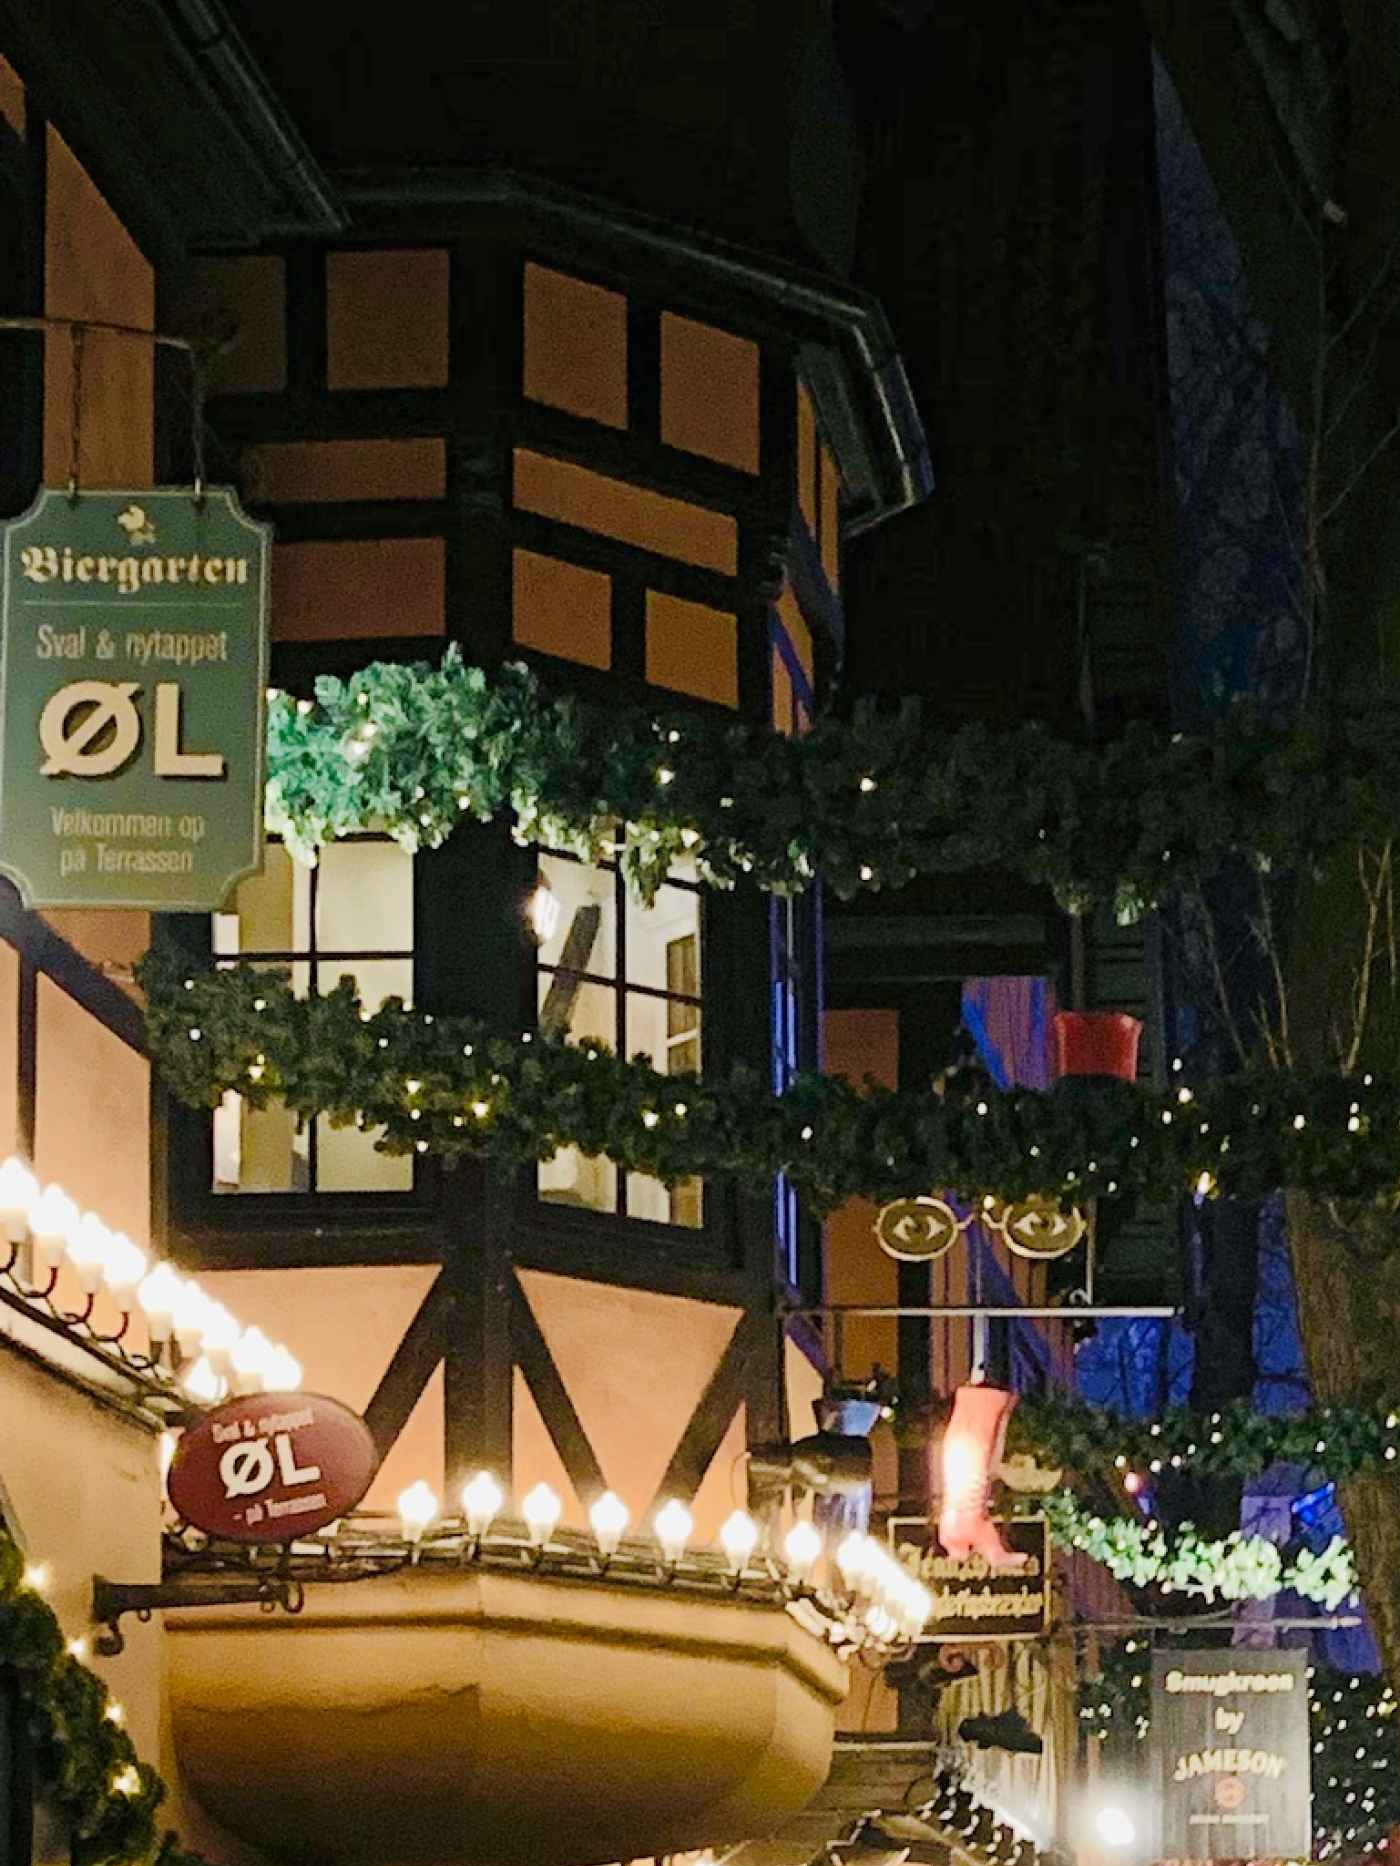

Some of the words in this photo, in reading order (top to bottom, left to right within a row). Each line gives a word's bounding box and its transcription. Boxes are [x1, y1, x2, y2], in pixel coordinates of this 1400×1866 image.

[21, 547, 248, 594] Biergarten
[37, 624, 86, 659] Sval
[96, 628, 115, 659] &
[127, 630, 227, 667] nytappet
[40, 680, 224, 777] ØL
[50, 806, 171, 838] Velkommen
[96, 843, 193, 873] Terrassen
[219, 1434, 322, 1500] ØL
[1165, 1670, 1295, 1697] Smugkroen
[1214, 1706, 1245, 1735] by
[1173, 1748, 1288, 1782] JAMESON
